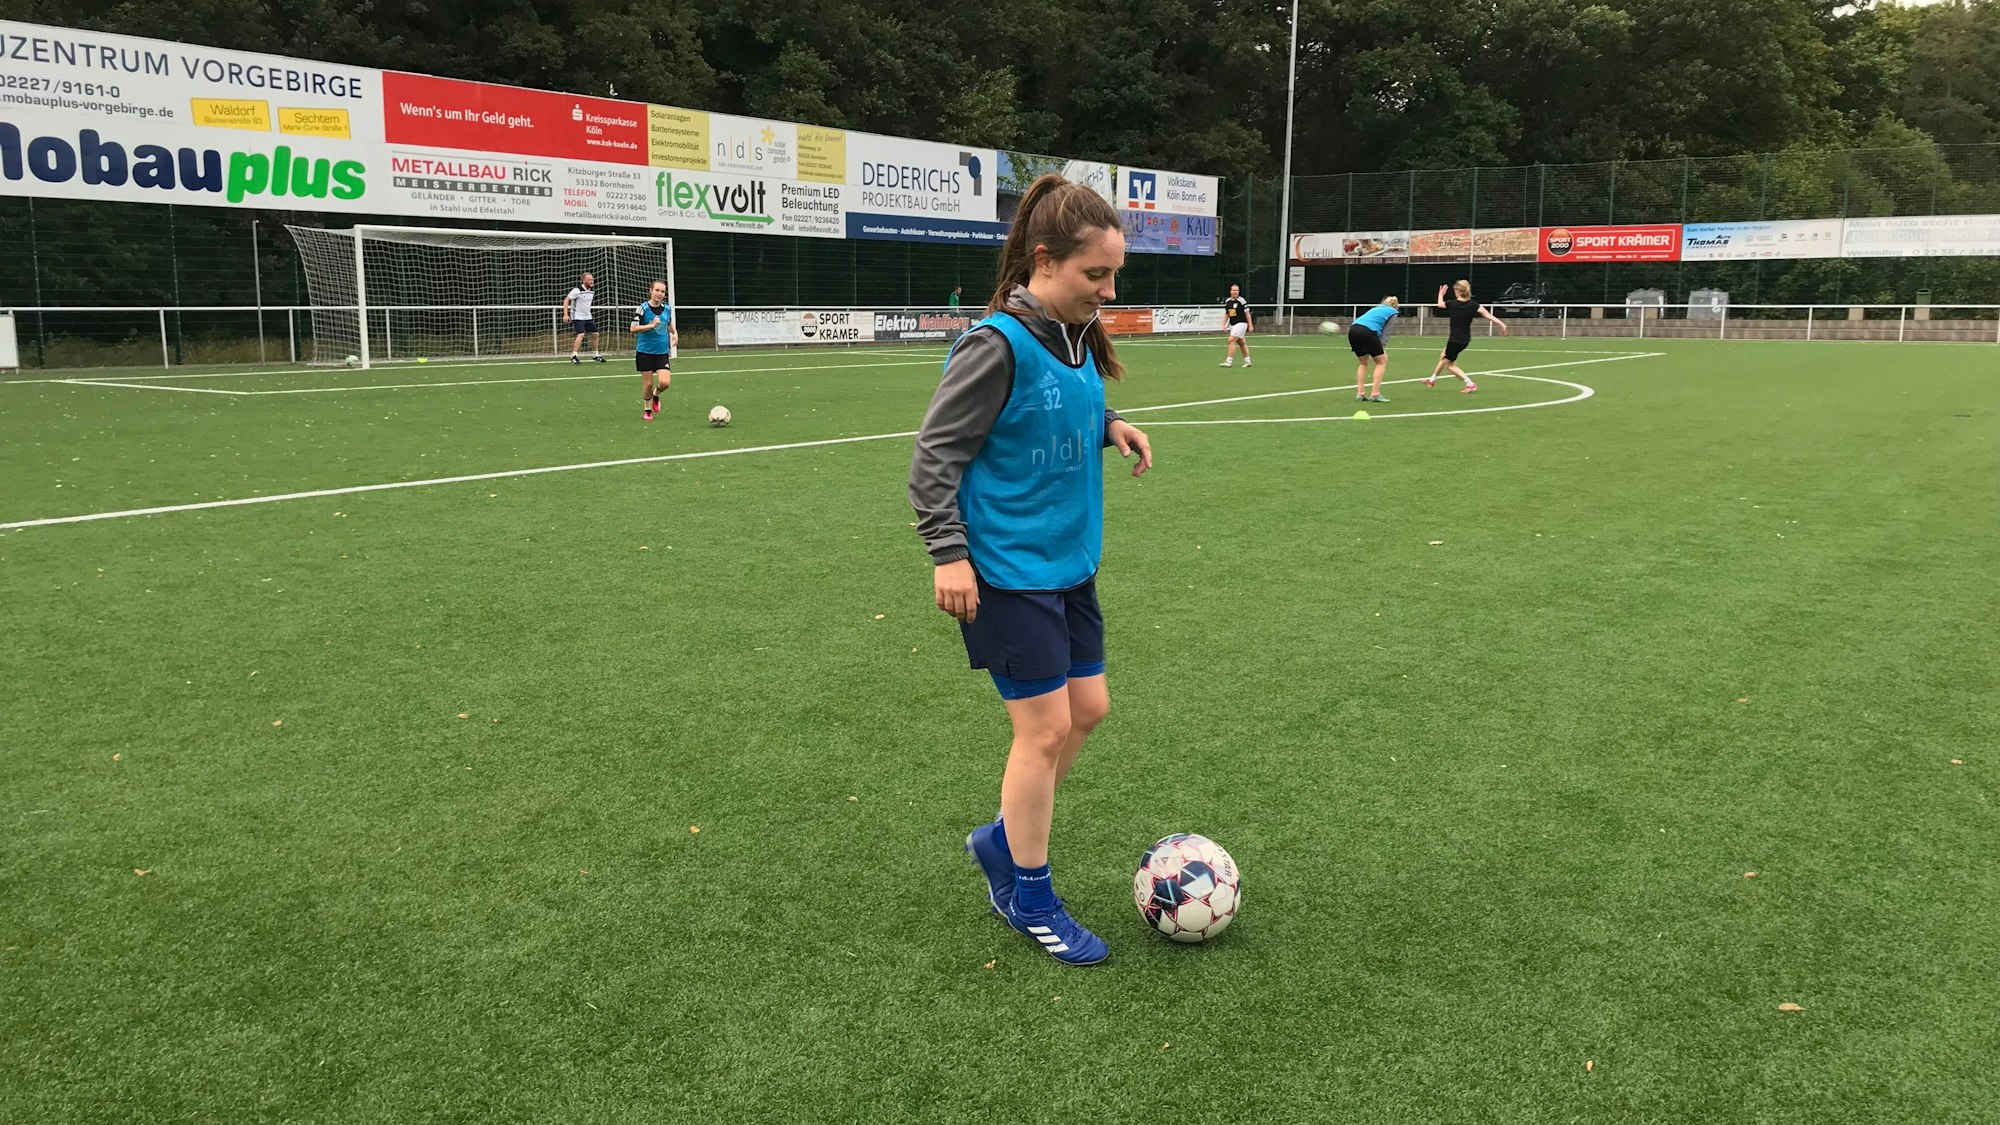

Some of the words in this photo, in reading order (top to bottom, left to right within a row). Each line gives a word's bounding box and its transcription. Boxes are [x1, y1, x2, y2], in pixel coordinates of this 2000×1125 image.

[0, 34, 170, 77] ZENTRUM
[181, 56, 363, 98] VORGEBIRGE
[210, 104, 256, 116] Waldorf
[650, 110, 691, 123] Solaranlagen
[444, 109, 462, 120] um
[464, 109, 480, 122] Ihr
[482, 111, 505, 125] Geld
[508, 115, 534, 129] geht.
[585, 113, 638, 128] Kreissparkasse
[586, 125, 603, 135] Köln
[651, 124, 700, 138] Batteriesysteme
[586, 138, 638, 150] www.ksk-koeln.de
[651, 138, 700, 151] Elektromobilität
[651, 152, 708, 166] Investorenprojekte
[391, 157, 506, 180] METALLBAU
[568, 167, 607, 178] Kitzburger
[608, 170, 631, 179] Straße
[862, 161, 961, 195] DEDERICHS
[1167, 176, 1197, 188] Volksbank
[395, 178, 552, 197] MEISTERBETRIEB
[599, 181, 635, 190] Bornheim
[781, 183, 821, 198] Premium
[823, 186, 840, 199] LED
[410, 191, 455, 202] GELÄNDER
[468, 195, 497, 204] GITTER
[511, 198, 531, 206] TORE
[564, 188, 597, 198] TELEFON
[656, 171, 766, 214] flexvolt
[1167, 190, 1181, 200] Köln
[1181, 191, 1196, 201] Bonn
[1197, 193, 1206, 203] eG
[564, 199, 588, 208] MOBIL
[781, 196, 839, 215] Beleuchtung
[862, 191, 928, 210] PROJEKTBAU
[931, 197, 961, 213] GmbH
[430, 203, 438, 211] in
[439, 204, 461, 213] Stahl
[479, 206, 516, 215] Edelstahl
[658, 208, 679, 218] GmbH
[685, 211, 697, 219] Co.
[782, 213, 793, 222] Fon
[1849, 219, 1881, 228] Mein
[1885, 218, 1918, 227] Auto
[720, 220, 764, 230] www.flexvolt.de
[782, 223, 795, 232] Mail
[1186, 216, 1211, 237] KAU
[1576, 236, 1617, 247] SPORT
[1618, 234, 1670, 246] KRÄMER
[1686, 237, 1730, 245] THOMAS
[819, 313, 850, 325] SPORT
[875, 314, 917, 331] Elektro
[918, 313, 970, 331] Mahlberg
[1177, 310, 1200, 327] GmbH
[819, 328, 859, 340] KRÄMER
[1043, 387, 1063, 411] 32
